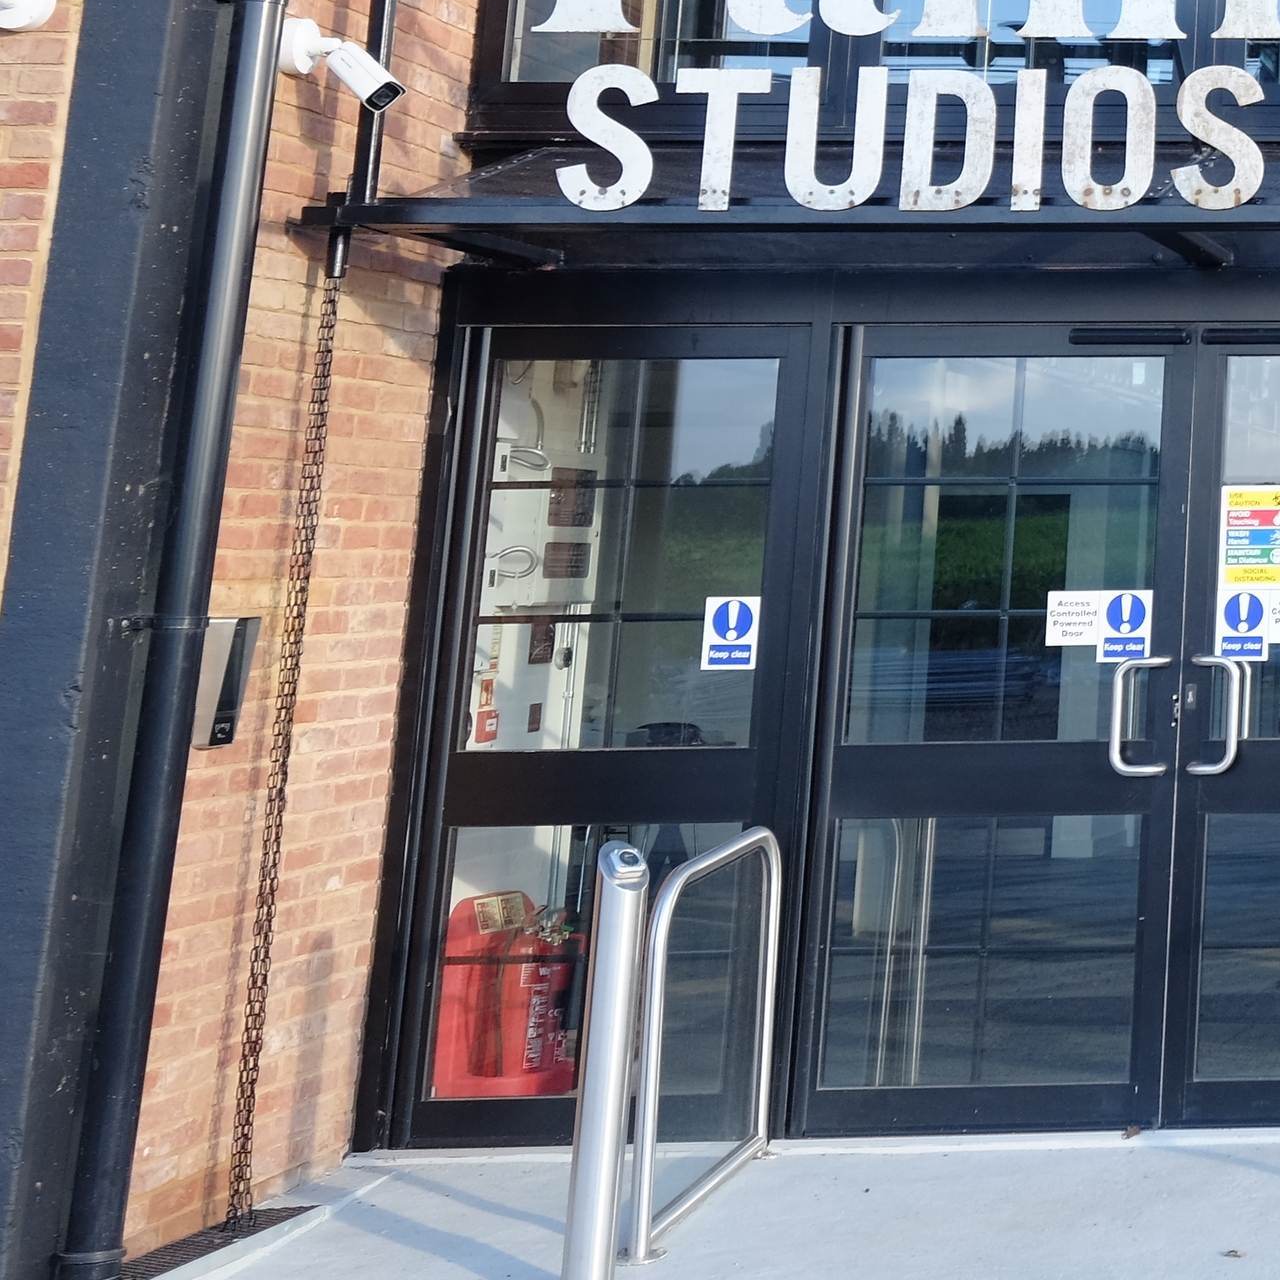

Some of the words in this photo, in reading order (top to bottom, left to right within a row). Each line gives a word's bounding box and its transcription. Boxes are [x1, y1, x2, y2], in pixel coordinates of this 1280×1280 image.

[555, 64, 1265, 211] STUDIOS
[1229, 518, 1260, 527] Touching
[1238, 556, 1268, 564] Distance
[1104, 642, 1123, 652] Keep
[1125, 642, 1145, 651] clear
[1222, 641, 1241, 651] Keep
[1243, 641, 1262, 650] clear
[709, 650, 729, 659] Keep
[730, 650, 750, 658] clear
